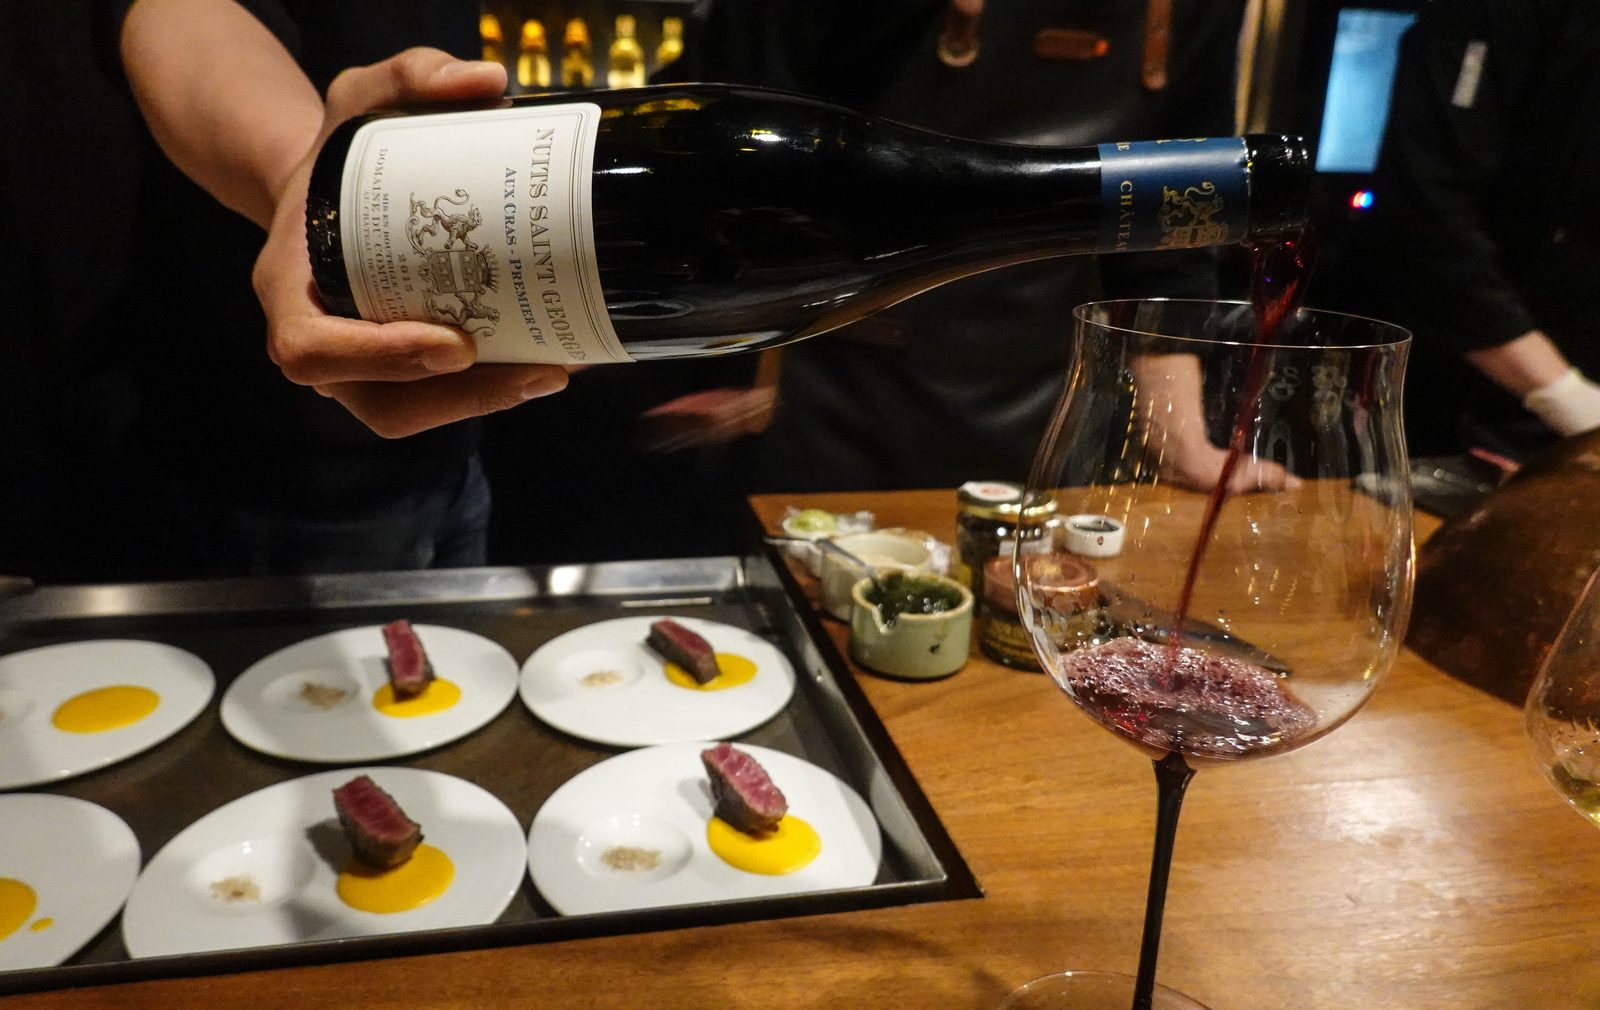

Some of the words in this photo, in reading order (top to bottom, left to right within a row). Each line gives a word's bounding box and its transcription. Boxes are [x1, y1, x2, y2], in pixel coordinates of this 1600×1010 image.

[372, 148, 388, 212] DOMAINE
[504, 167, 517, 199] AUX
[530, 127, 555, 199] NUITS
[372, 217, 381, 238] DU
[383, 214, 389, 228] EN
[503, 203, 517, 246] CRAS
[375, 243, 392, 293] COMTE
[383, 231, 399, 288] BOUTEILLE
[530, 206, 557, 284] SAINT
[398, 254, 414, 292] 2015
[508, 258, 536, 325] PREMIER
[529, 327, 548, 347] CRU
